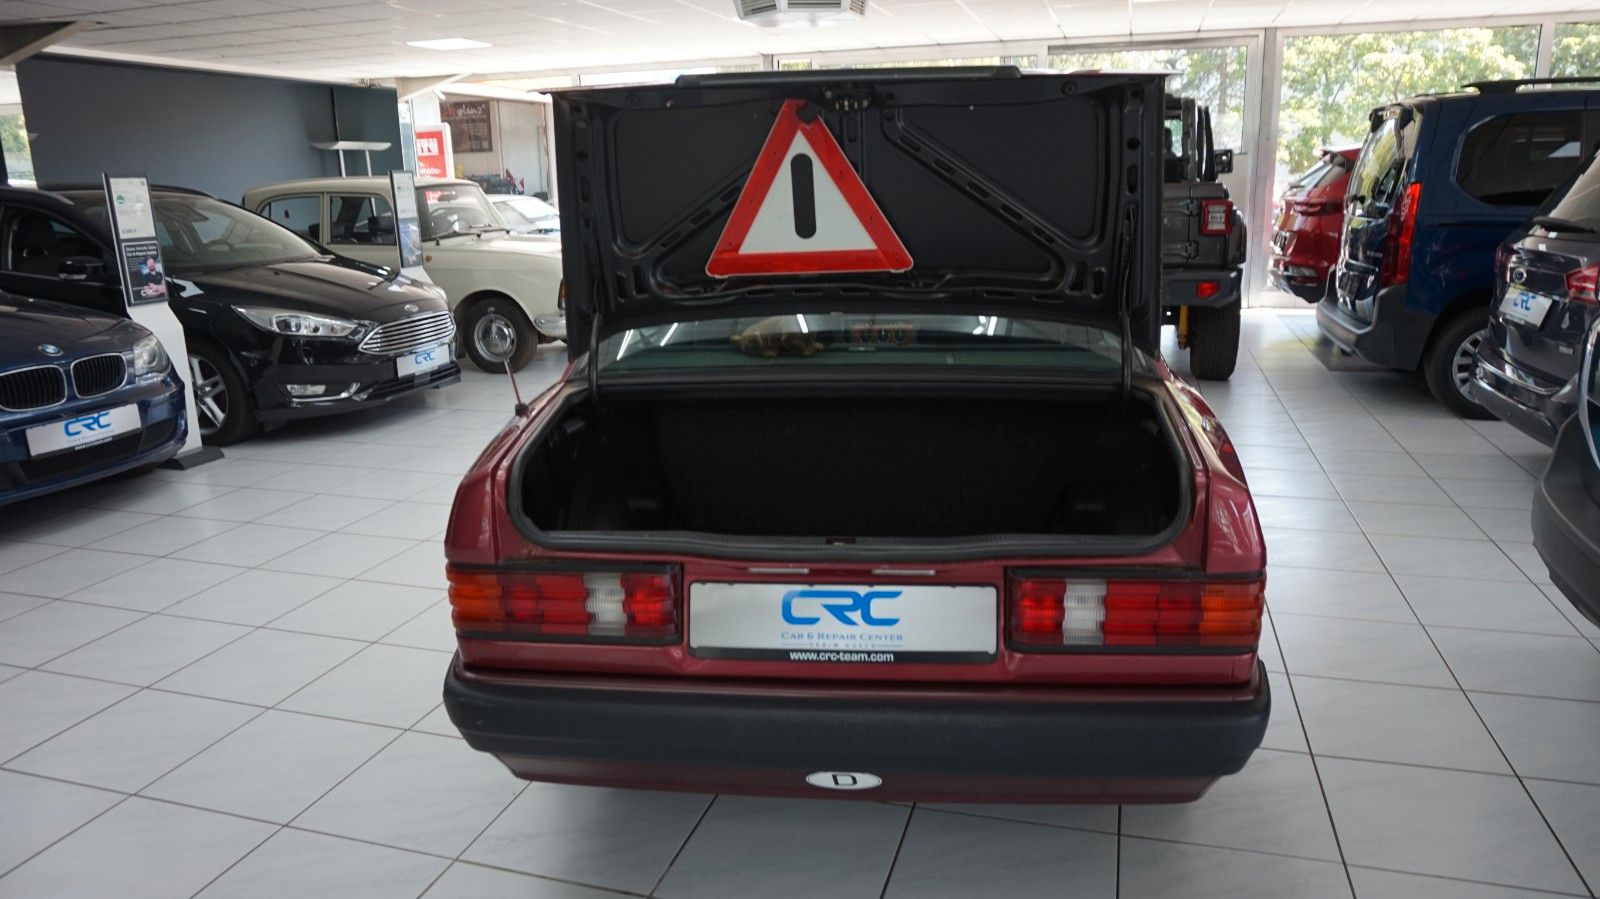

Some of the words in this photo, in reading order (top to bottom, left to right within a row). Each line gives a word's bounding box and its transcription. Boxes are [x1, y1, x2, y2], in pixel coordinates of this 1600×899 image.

[415, 349, 435, 365] CRC
[64, 411, 111, 437] CRC
[781, 589, 903, 627] CRC
[790, 651, 894, 663] www.crc-team.com
[831, 773, 858, 786] D
